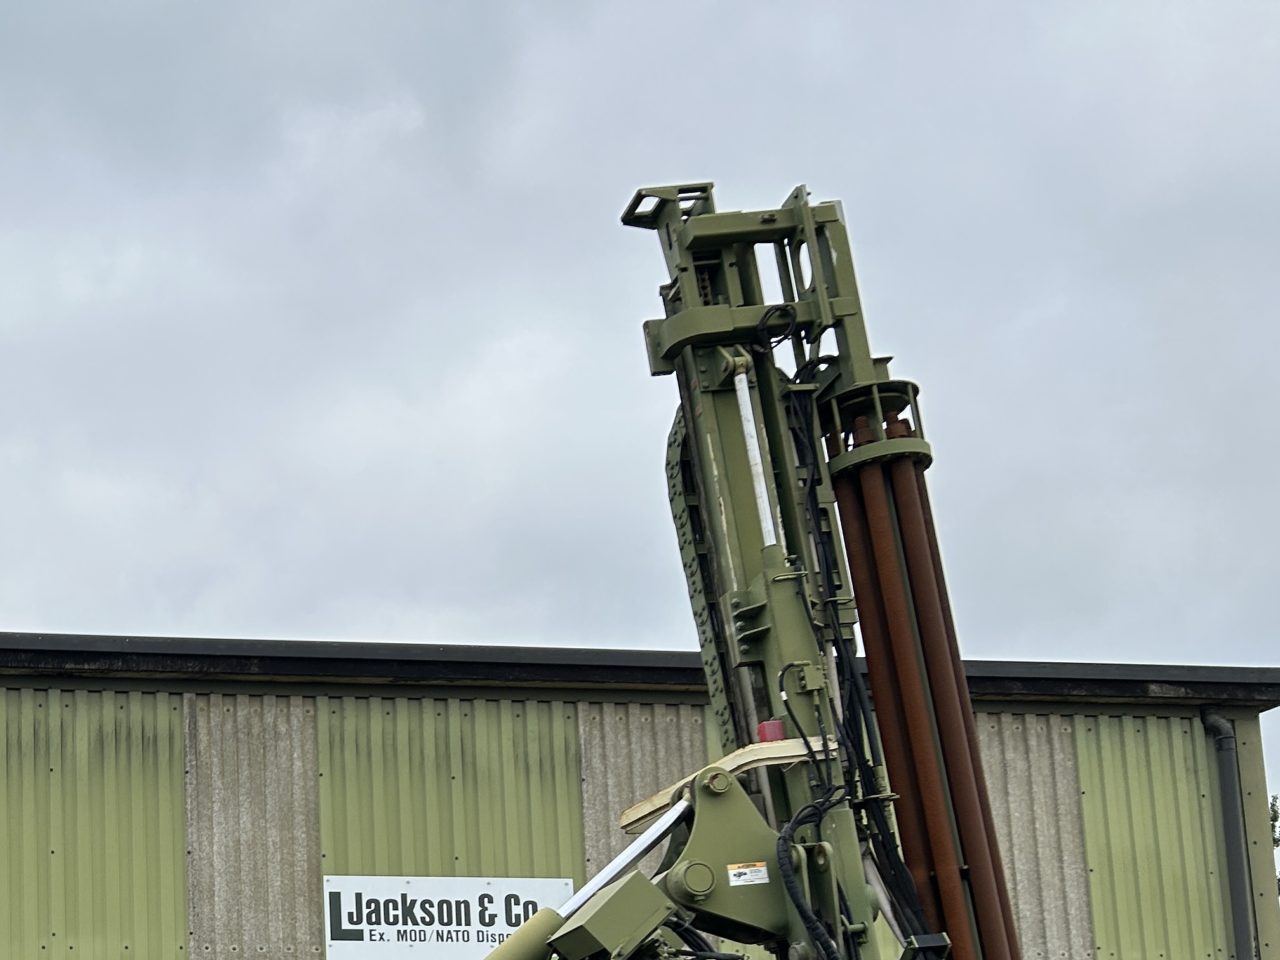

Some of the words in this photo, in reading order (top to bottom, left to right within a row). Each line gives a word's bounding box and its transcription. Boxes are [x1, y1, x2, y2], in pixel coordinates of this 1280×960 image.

[478, 893, 498, 928] &
[369, 929, 391, 942] Ex.
[396, 929, 471, 943] MOD/NATO
